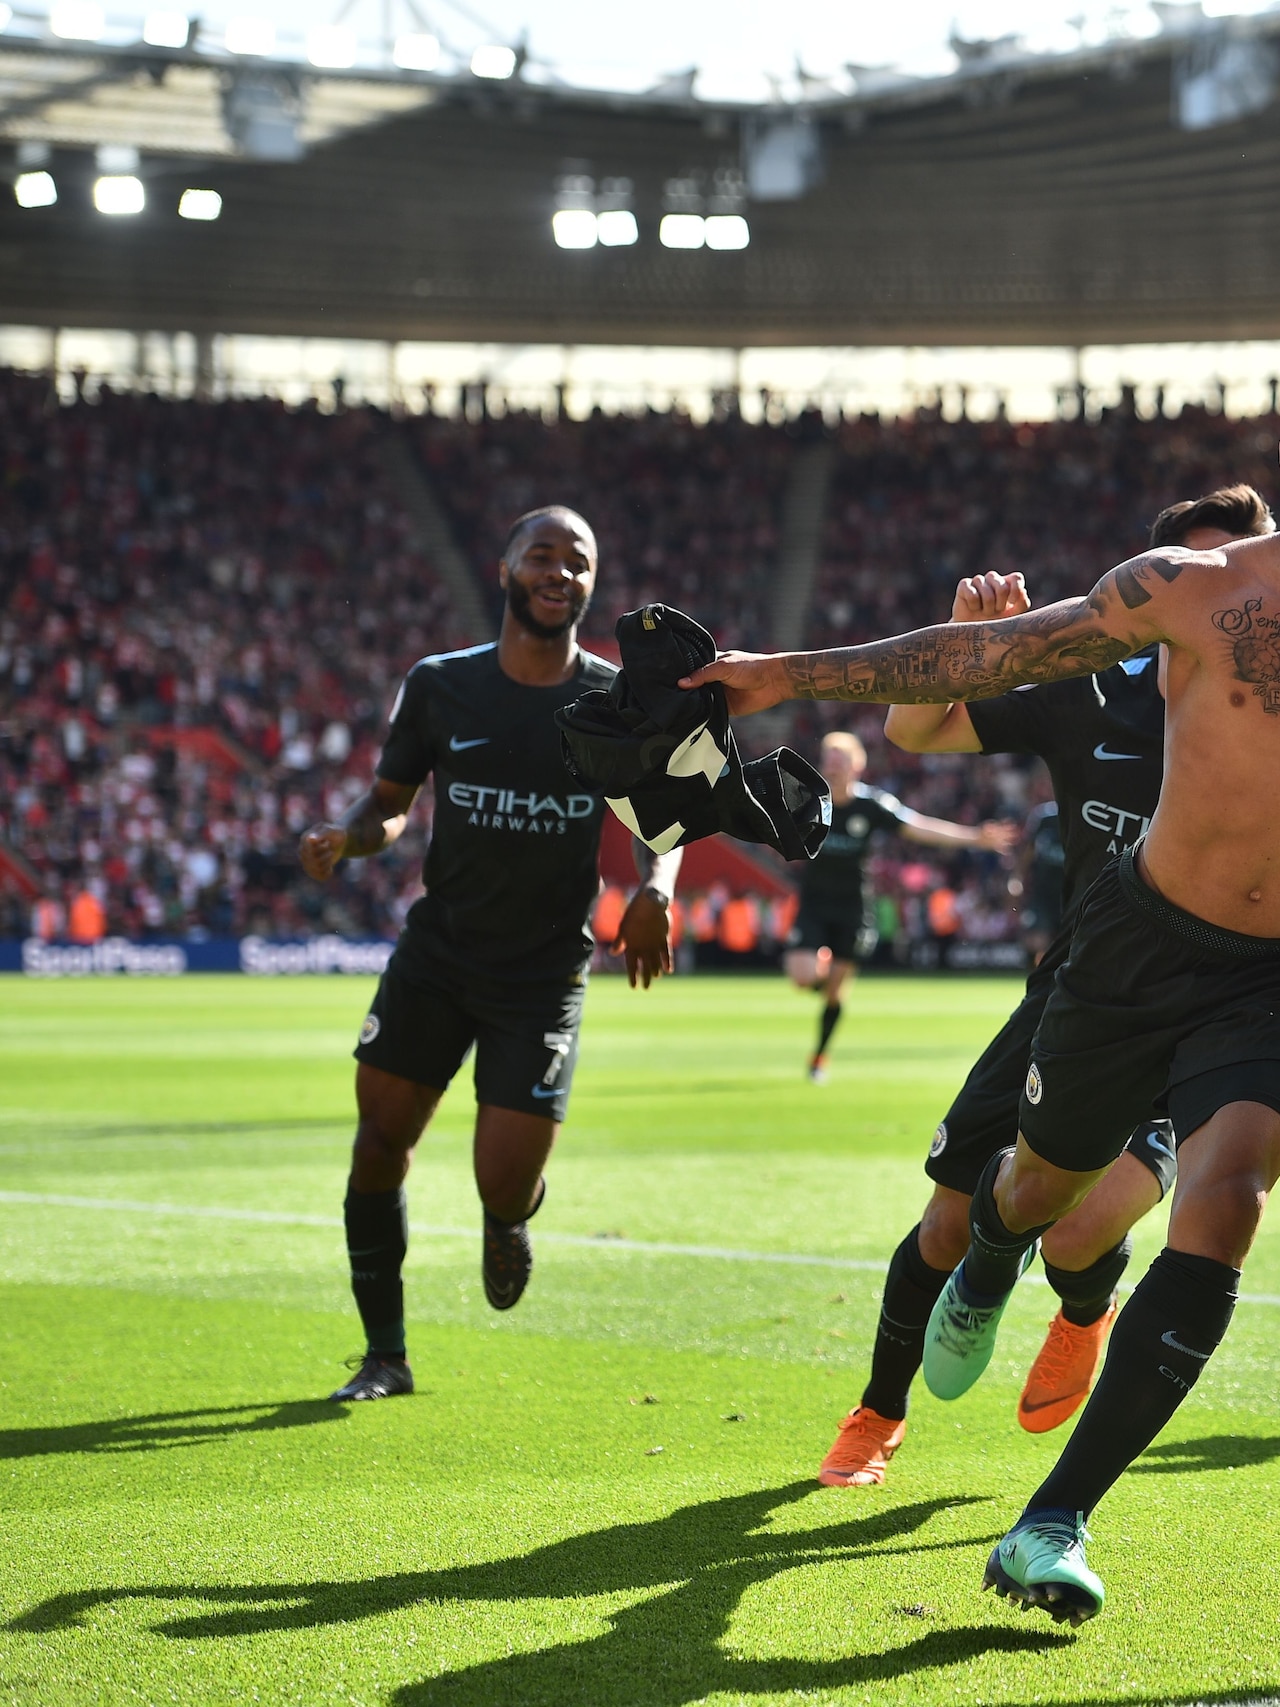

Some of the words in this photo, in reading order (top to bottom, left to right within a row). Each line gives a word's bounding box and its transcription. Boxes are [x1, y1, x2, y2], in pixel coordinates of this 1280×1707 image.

[448, 781, 595, 819] ETIHAD
[468, 811, 568, 835] AIRWAYS
[543, 1031, 573, 1086] 7
